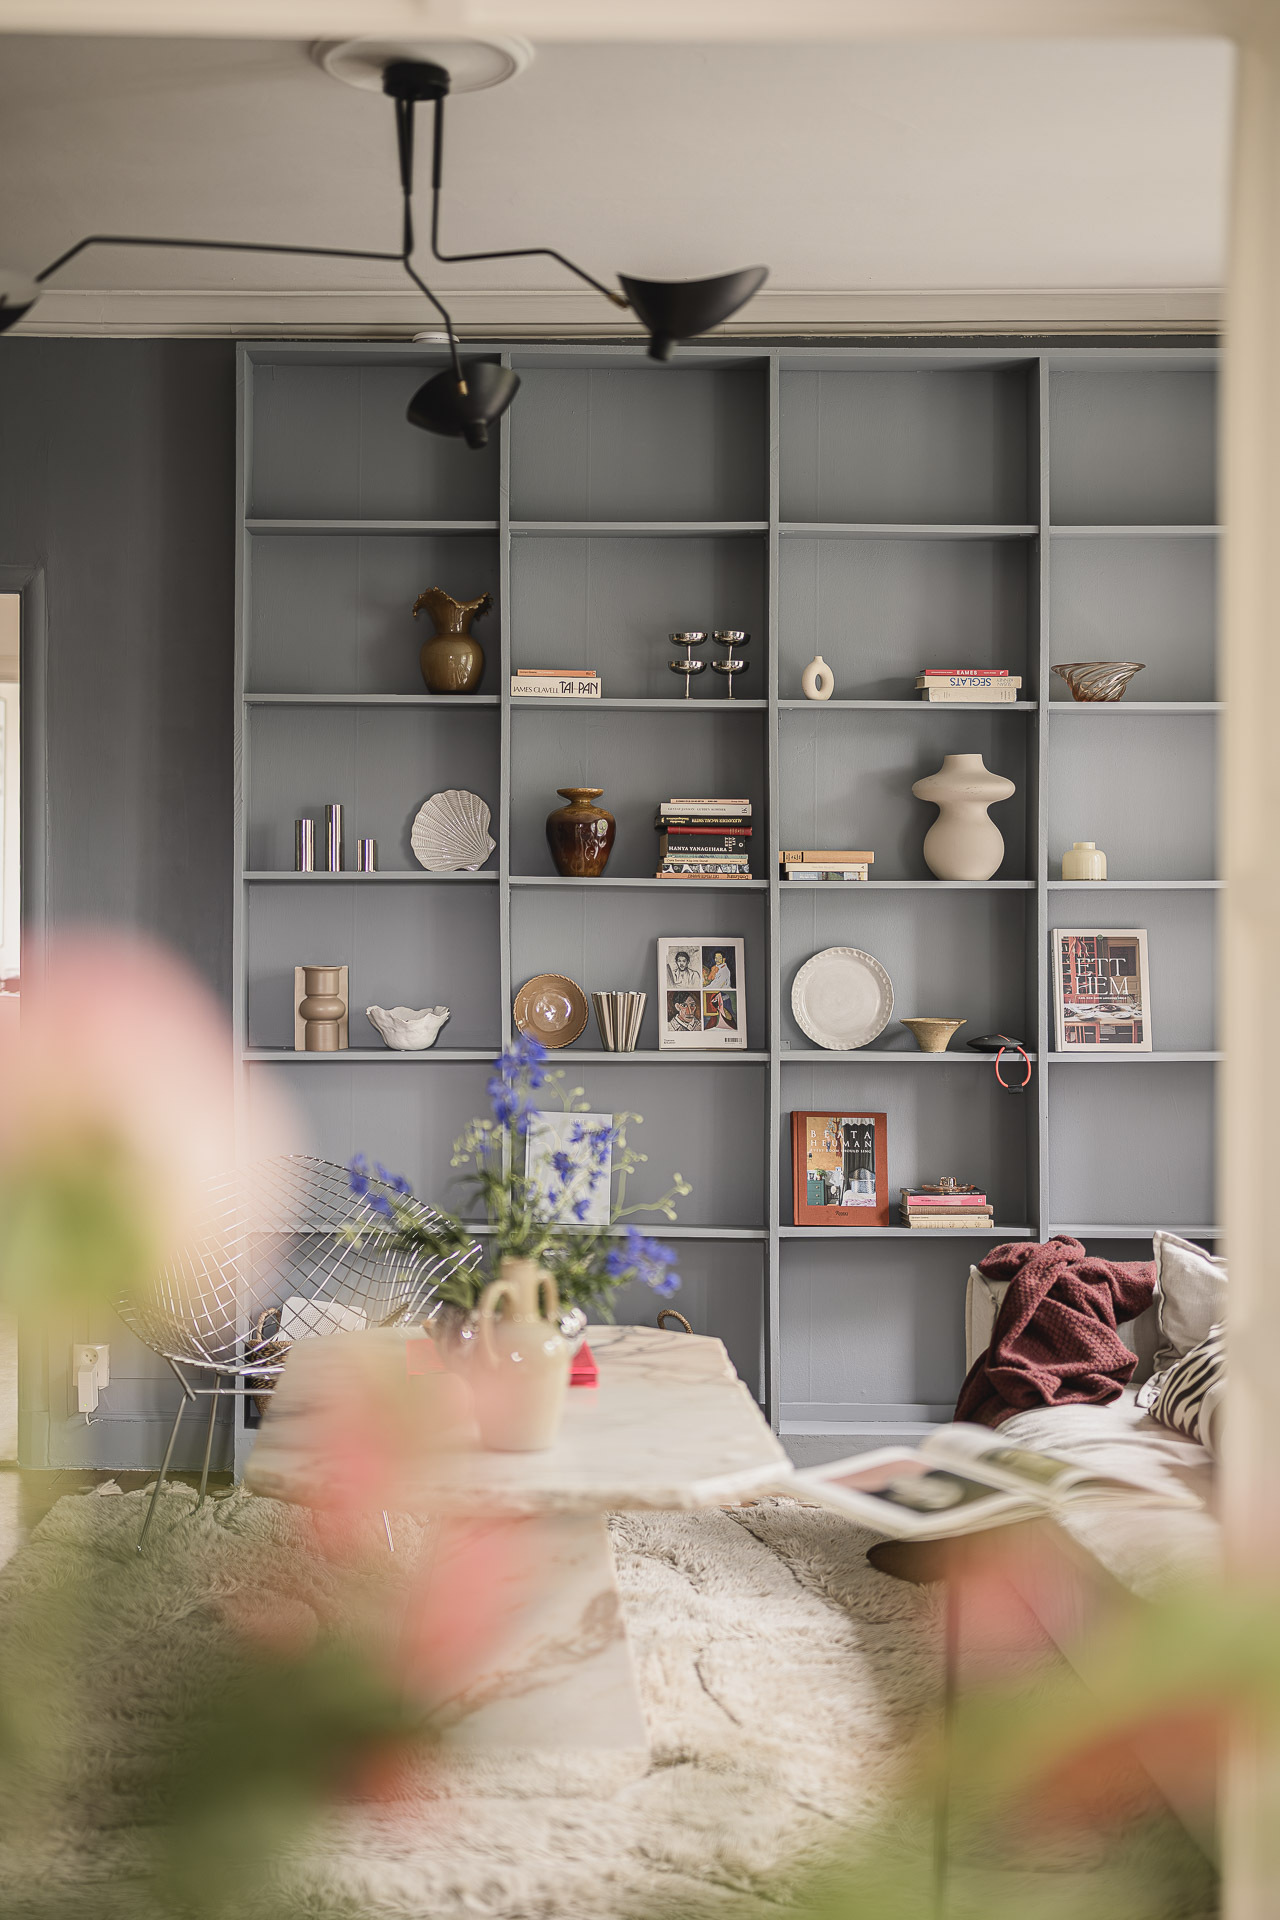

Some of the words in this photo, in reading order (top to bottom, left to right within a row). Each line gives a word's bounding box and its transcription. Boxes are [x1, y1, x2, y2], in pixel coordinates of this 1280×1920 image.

[949, 677, 992, 686] SEGLATS
[533, 686, 559, 694] CLAVELL
[1076, 957, 1127, 976] ETT
[1075, 976, 1129, 995] HEM
[810, 1130, 872, 1139] BEATA
[810, 1139, 872, 1148] HEUMAN
